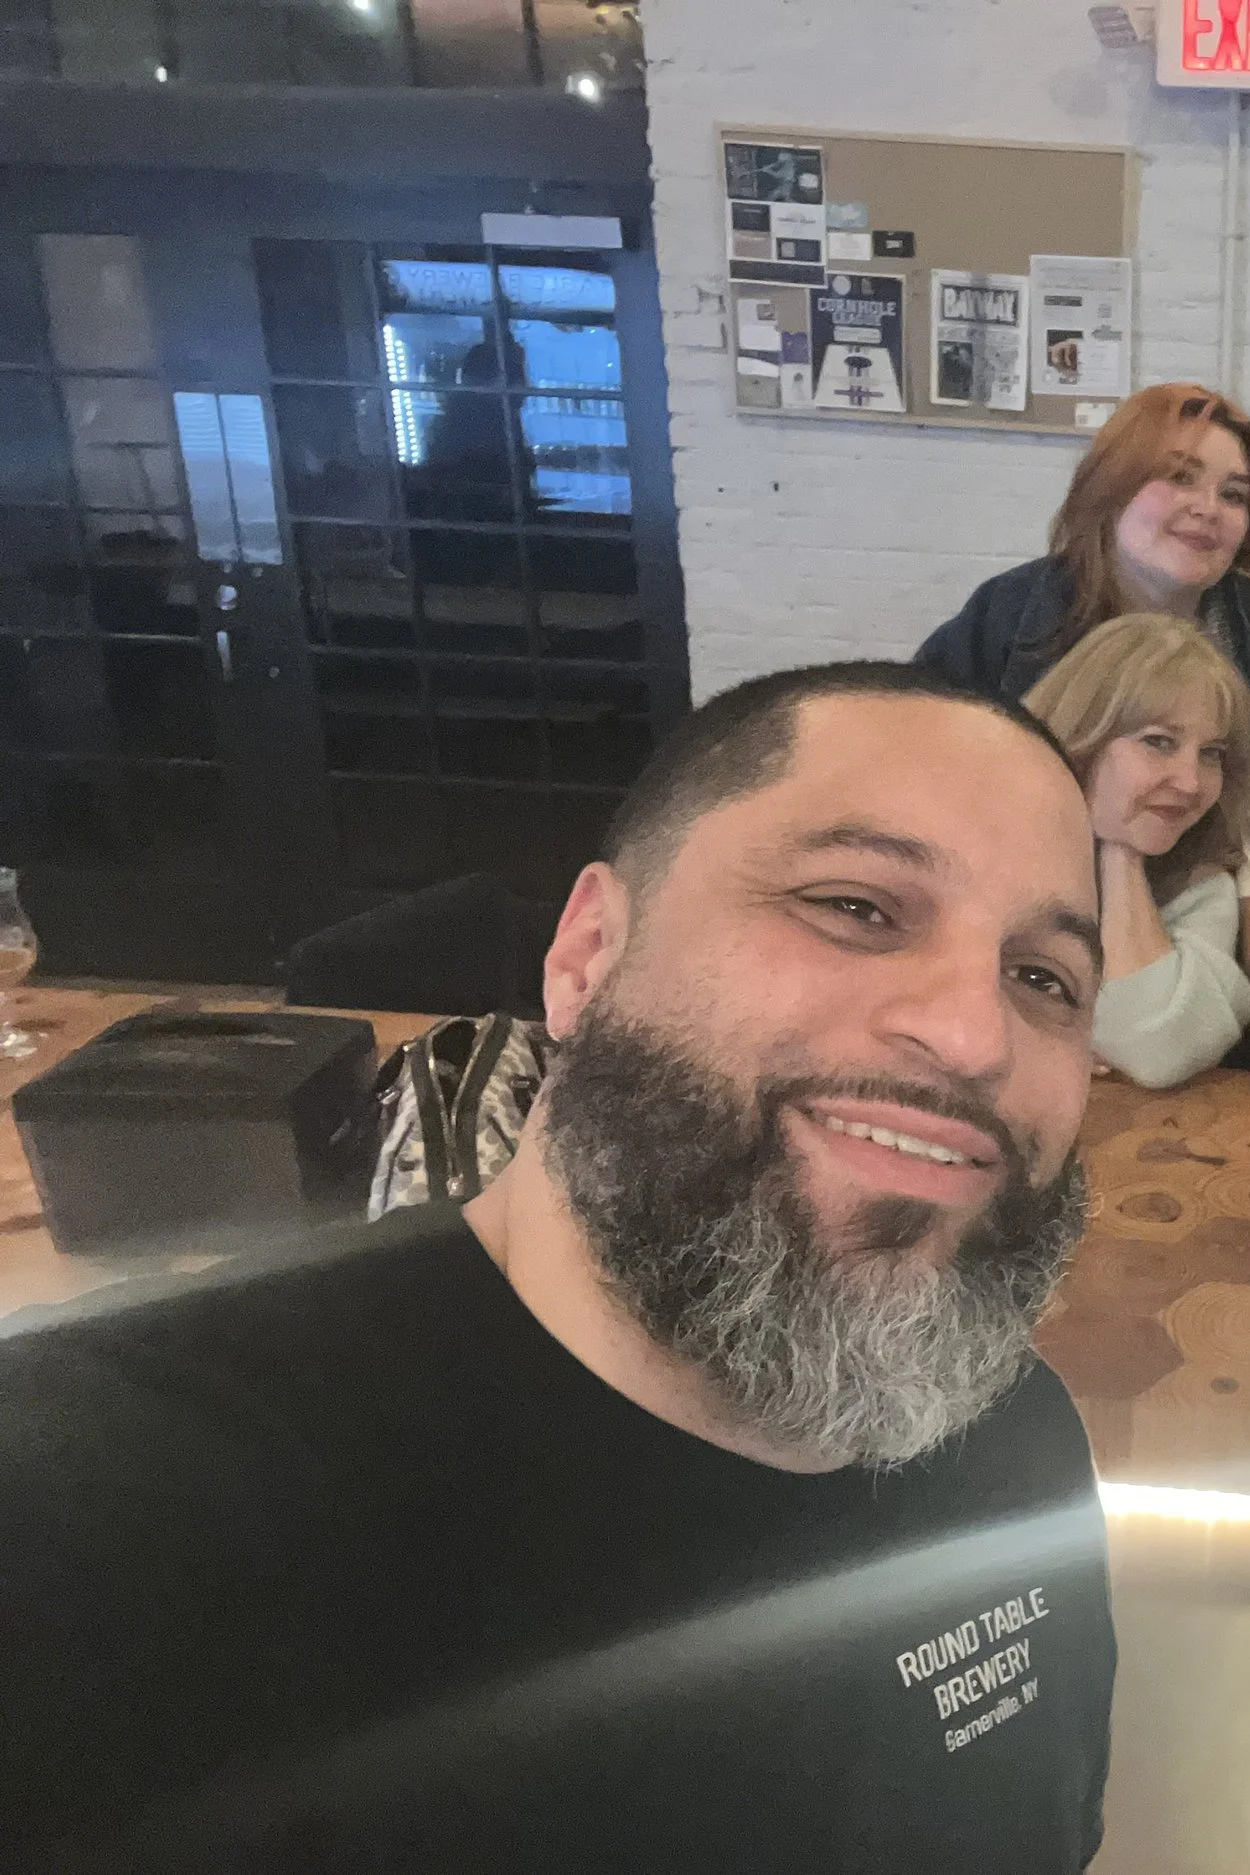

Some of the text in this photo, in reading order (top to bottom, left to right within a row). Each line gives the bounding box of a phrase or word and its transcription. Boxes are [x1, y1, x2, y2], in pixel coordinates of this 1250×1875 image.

[896, 1587, 1050, 1688] ROUND TABLE
[933, 1638, 1031, 1720] BREWERY
[1021, 1677, 1038, 1705] NY
